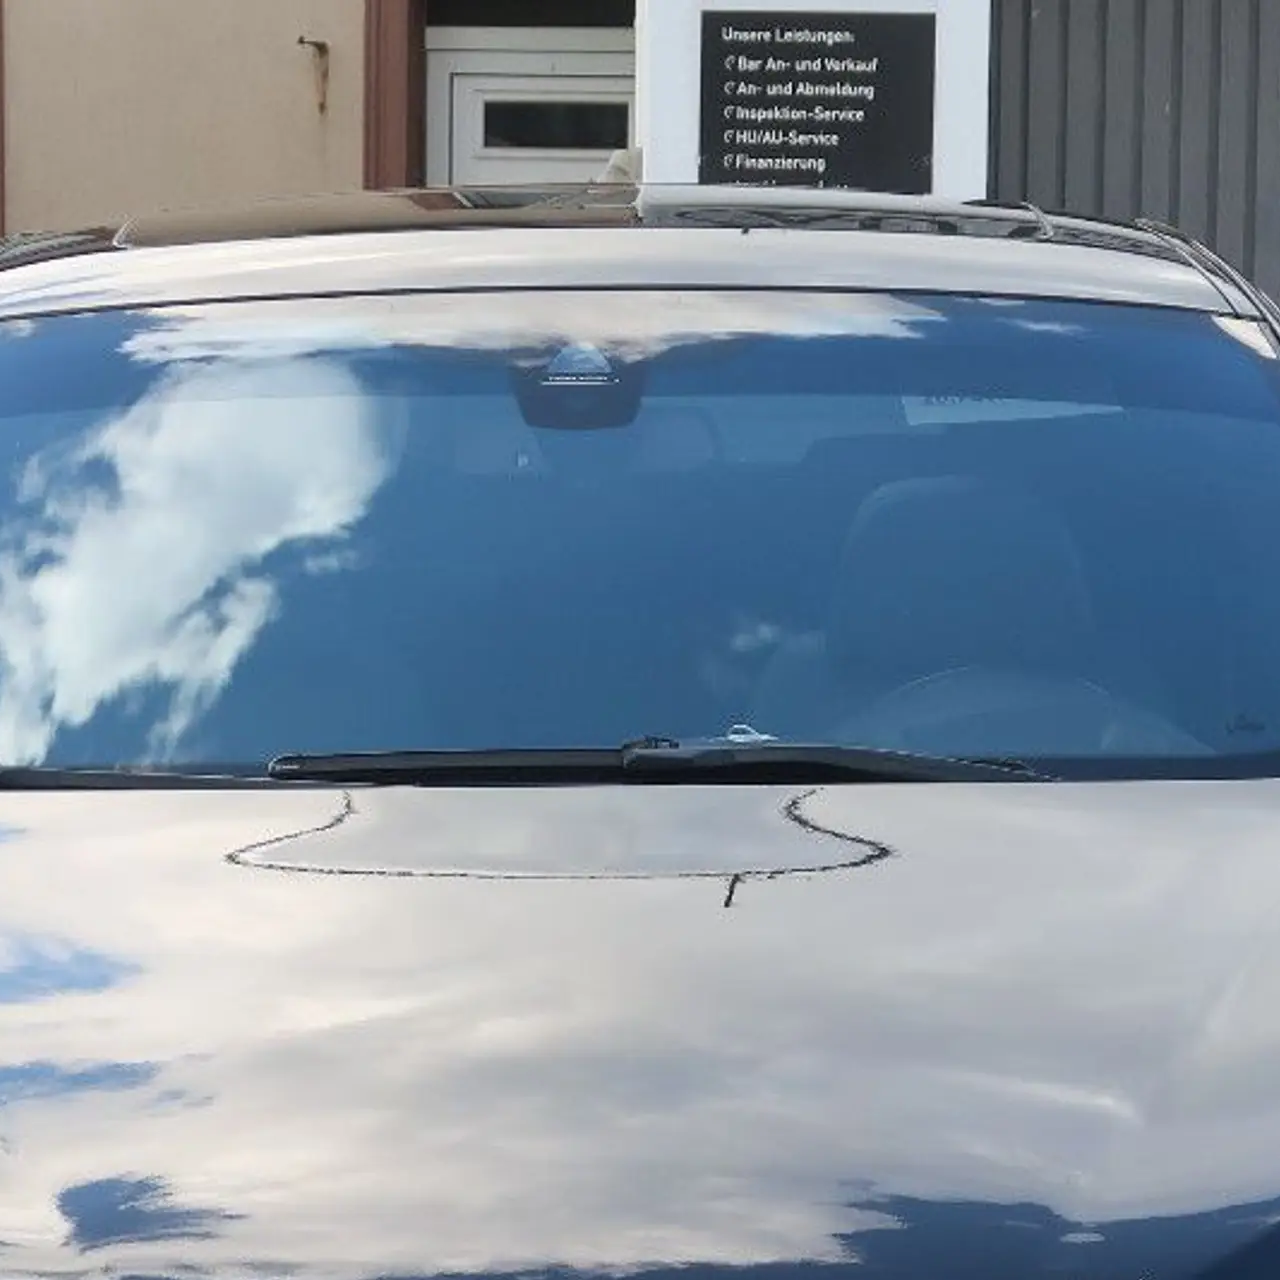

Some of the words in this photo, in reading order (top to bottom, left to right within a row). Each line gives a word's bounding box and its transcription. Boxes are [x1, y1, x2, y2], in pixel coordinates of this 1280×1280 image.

[721, 26, 770, 42] Unsere
[774, 27, 855, 46] Leistungen:
[738, 55, 761, 71] Bar
[765, 56, 791, 71] An-
[795, 57, 821, 72] und
[824, 57, 878, 72] Verkauf
[736, 81, 762, 96] An-
[766, 82, 793, 96] und
[796, 81, 874, 100] Abmeldung
[736, 106, 865, 122] Inspektion-Service
[736, 130, 839, 146] HU/AU-Service
[735, 153, 826, 173] Finanzierung
